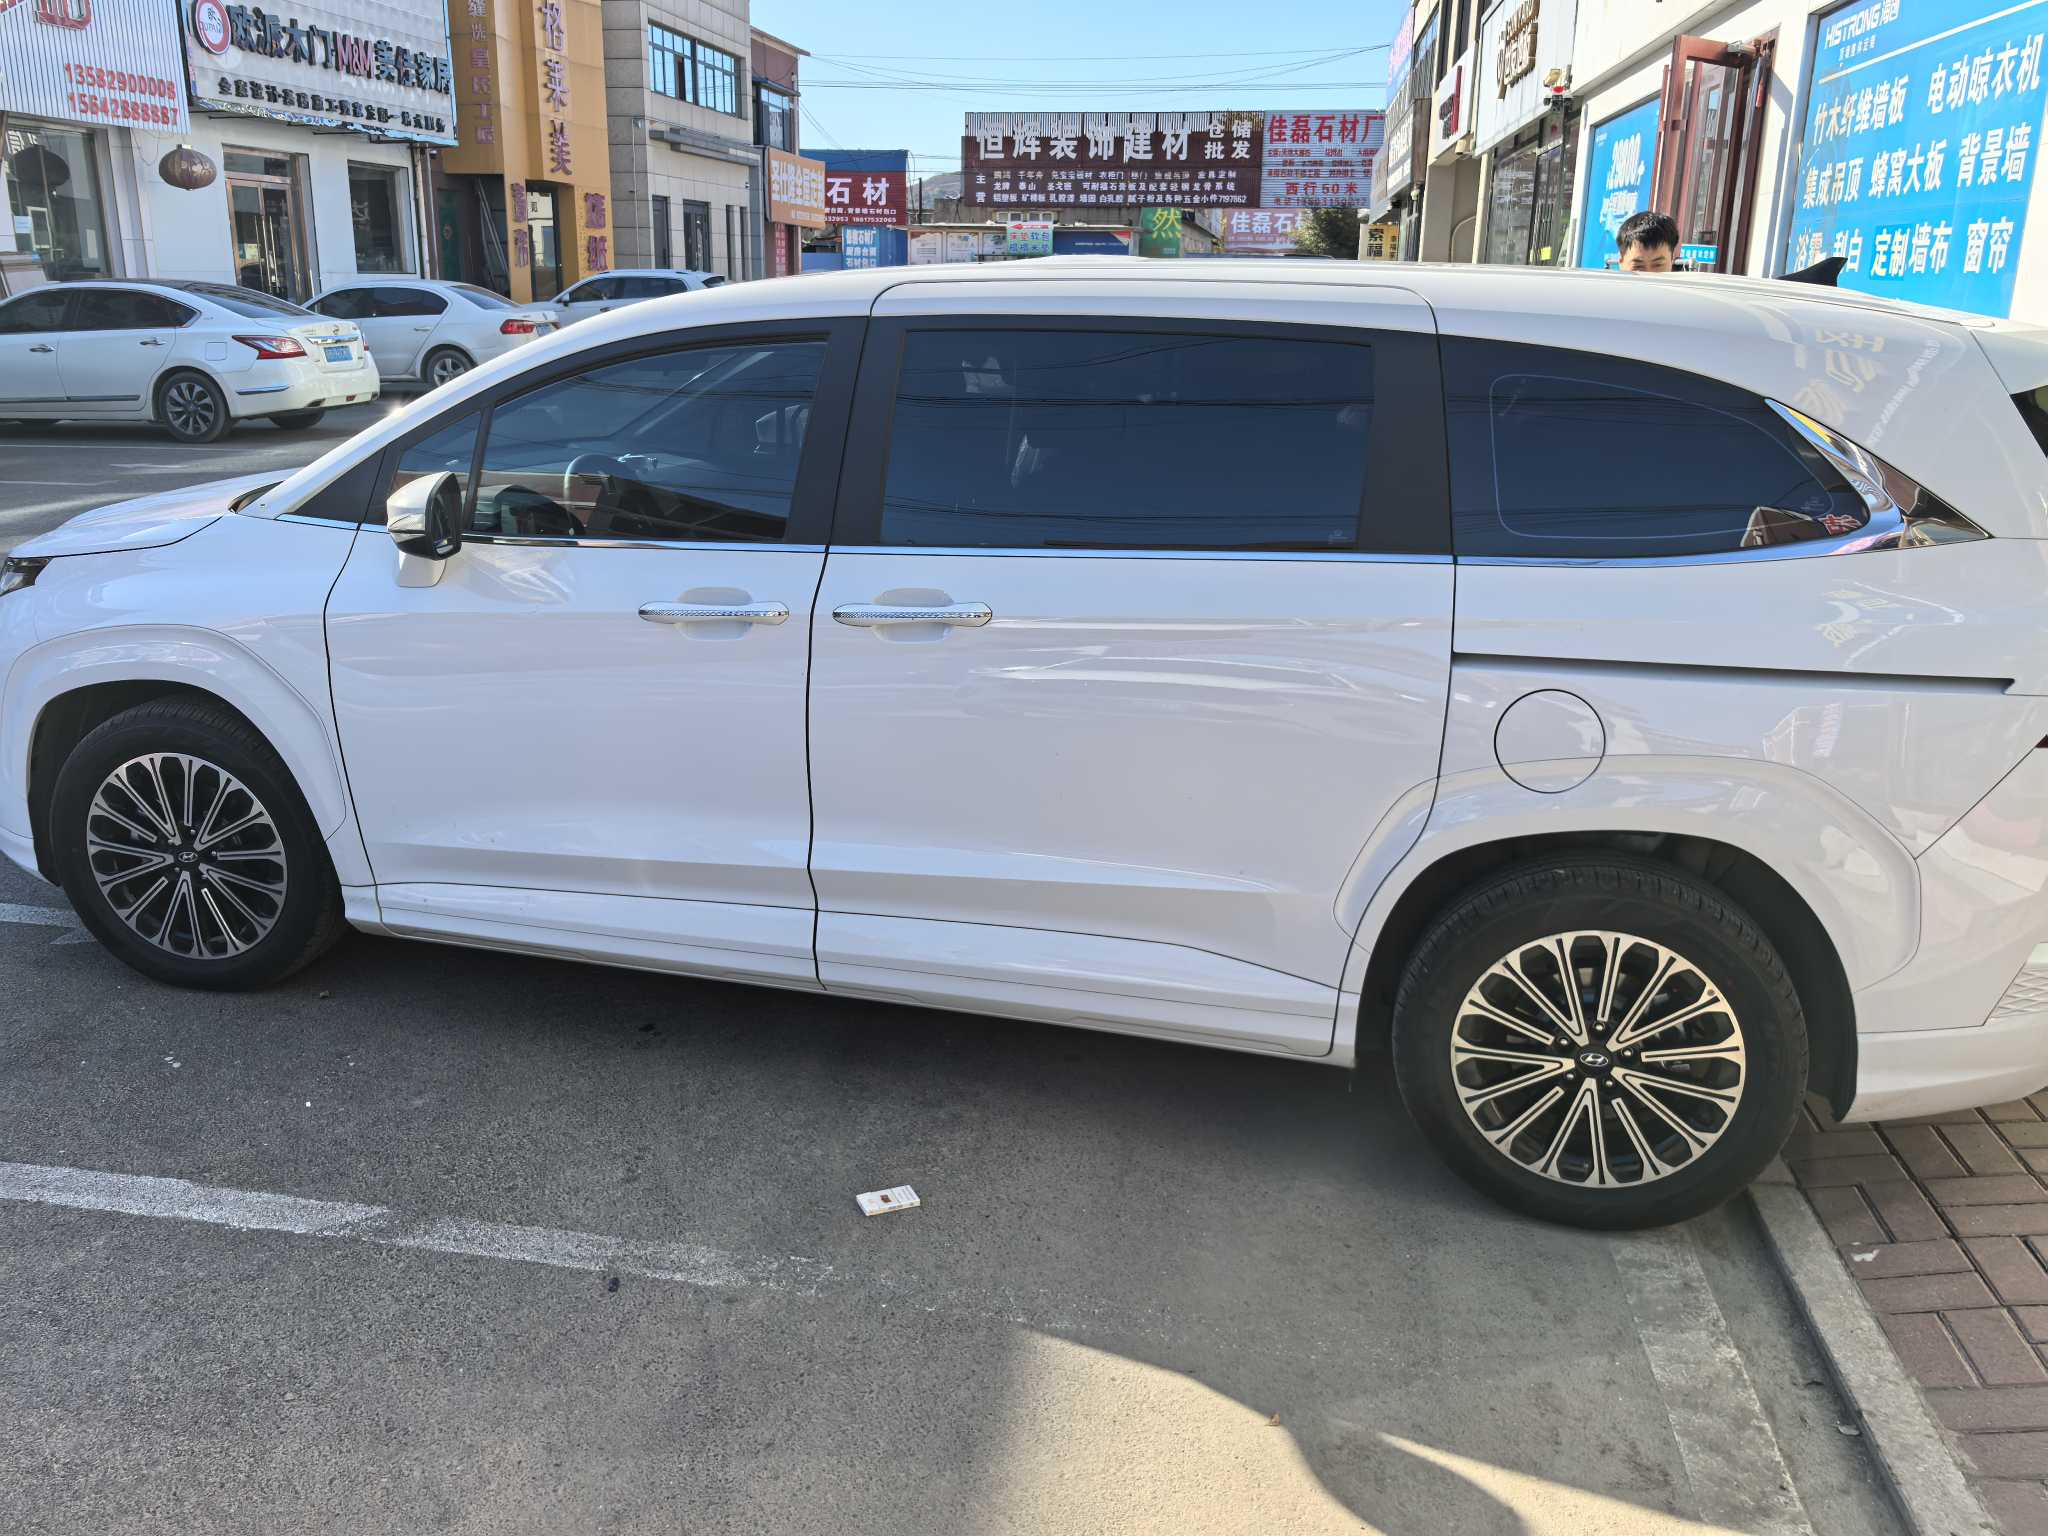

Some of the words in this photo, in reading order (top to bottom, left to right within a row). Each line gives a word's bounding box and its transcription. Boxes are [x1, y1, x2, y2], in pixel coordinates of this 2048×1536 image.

[65, 63, 176, 101] 13582900008
[1927, 33, 2045, 115] 电动晾衣机
[1206, 119, 1252, 139] 仓储
[1267, 114, 1385, 145] 佳磊石材厂
[1813, 74, 1909, 147] 竹木纤维墙板
[976, 117, 1192, 164] 恒辉装饰建材
[1204, 141, 1251, 160] 批发
[1802, 156, 1864, 209] 集成吊顶
[1868, 139, 1948, 199] 蜂窝大板
[1956, 122, 2032, 188] 背景墙
[827, 177, 890, 206] 石材
[1153, 207, 1182, 240] 然
[1870, 220, 1952, 277] 定制墙布
[1962, 216, 2015, 275] 窗帘
